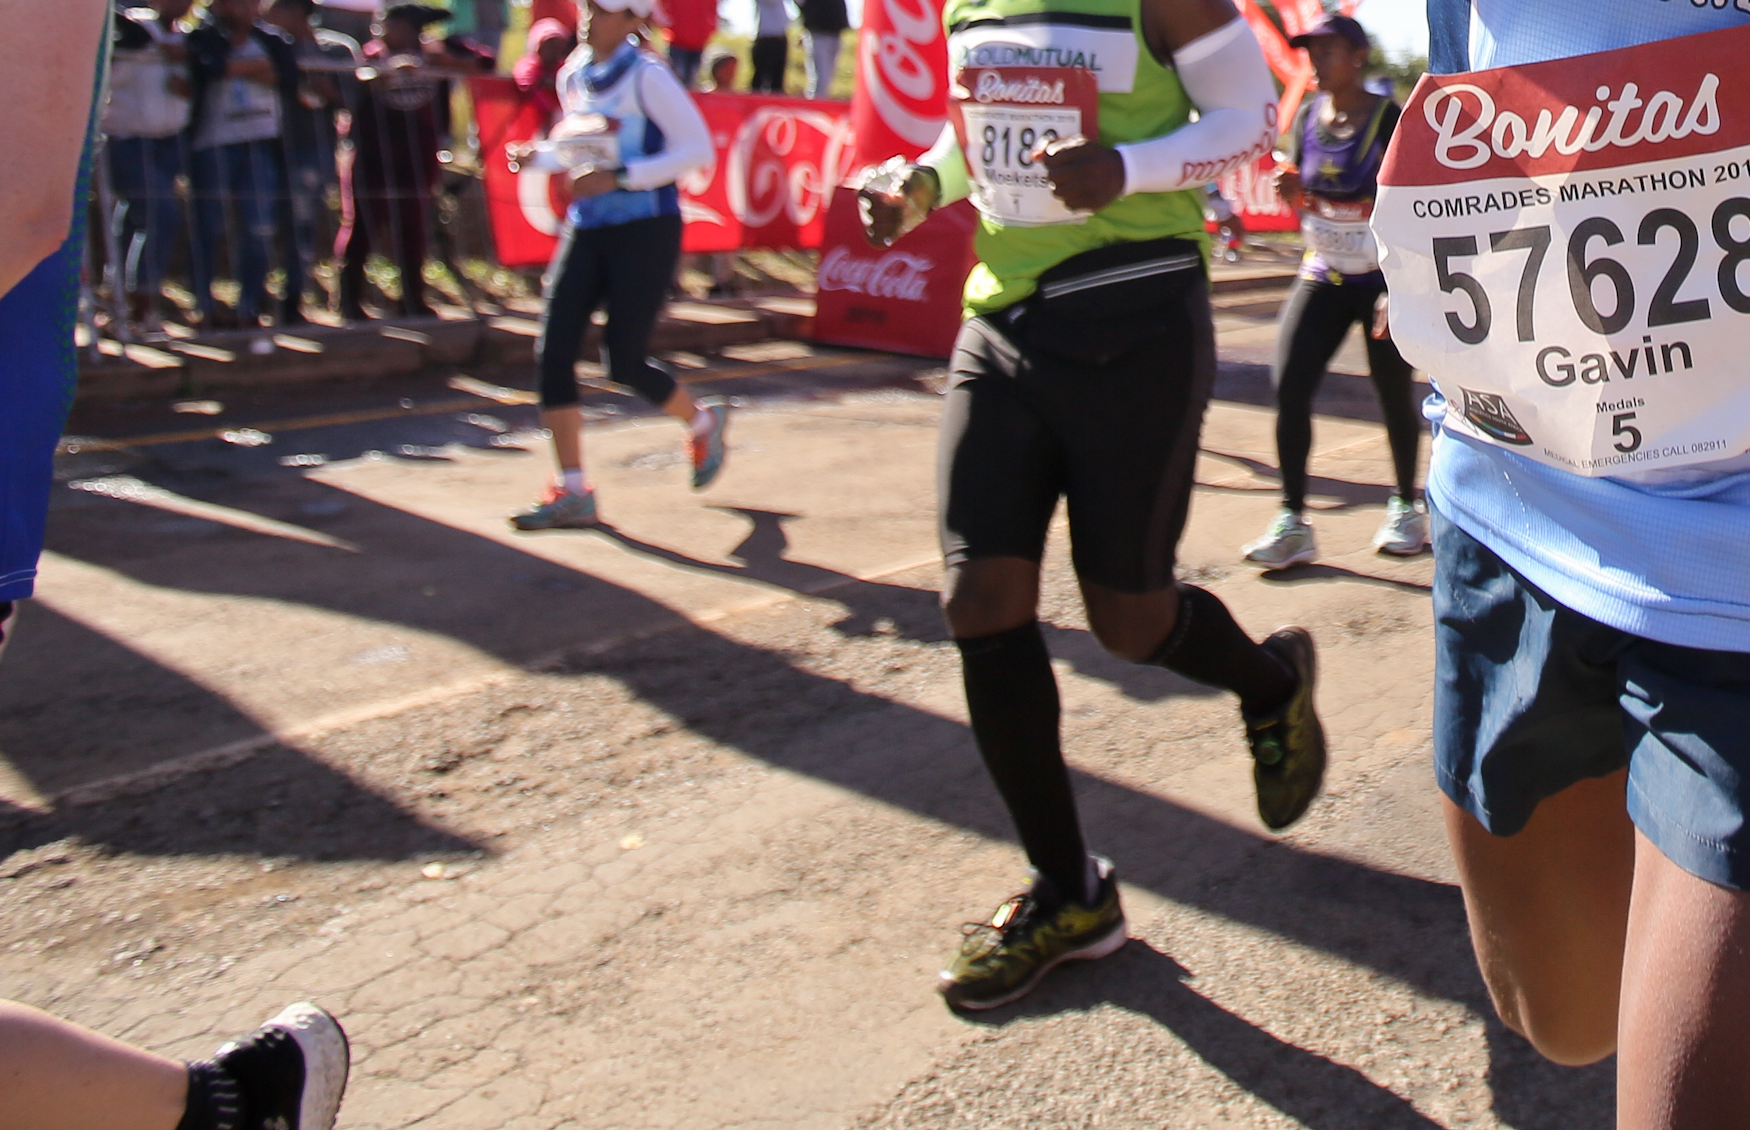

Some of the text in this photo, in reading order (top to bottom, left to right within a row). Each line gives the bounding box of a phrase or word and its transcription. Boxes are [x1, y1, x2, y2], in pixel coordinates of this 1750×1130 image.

[974, 70, 1066, 104] Bonitas
[1422, 72, 1721, 171] Bonitas
[1412, 187, 1552, 219] COMRADES
[1559, 166, 1707, 203] MARATHON
[1535, 335, 1694, 389] Gavin
[1466, 390, 1518, 426] ASA
[1595, 396, 1646, 415] Medals
[1611, 411, 1644, 455] 5
[1581, 449, 1660, 469] EMERGENCIES
[1662, 446, 1689, 460] CALL
[1691, 438, 1728, 454] 082911
